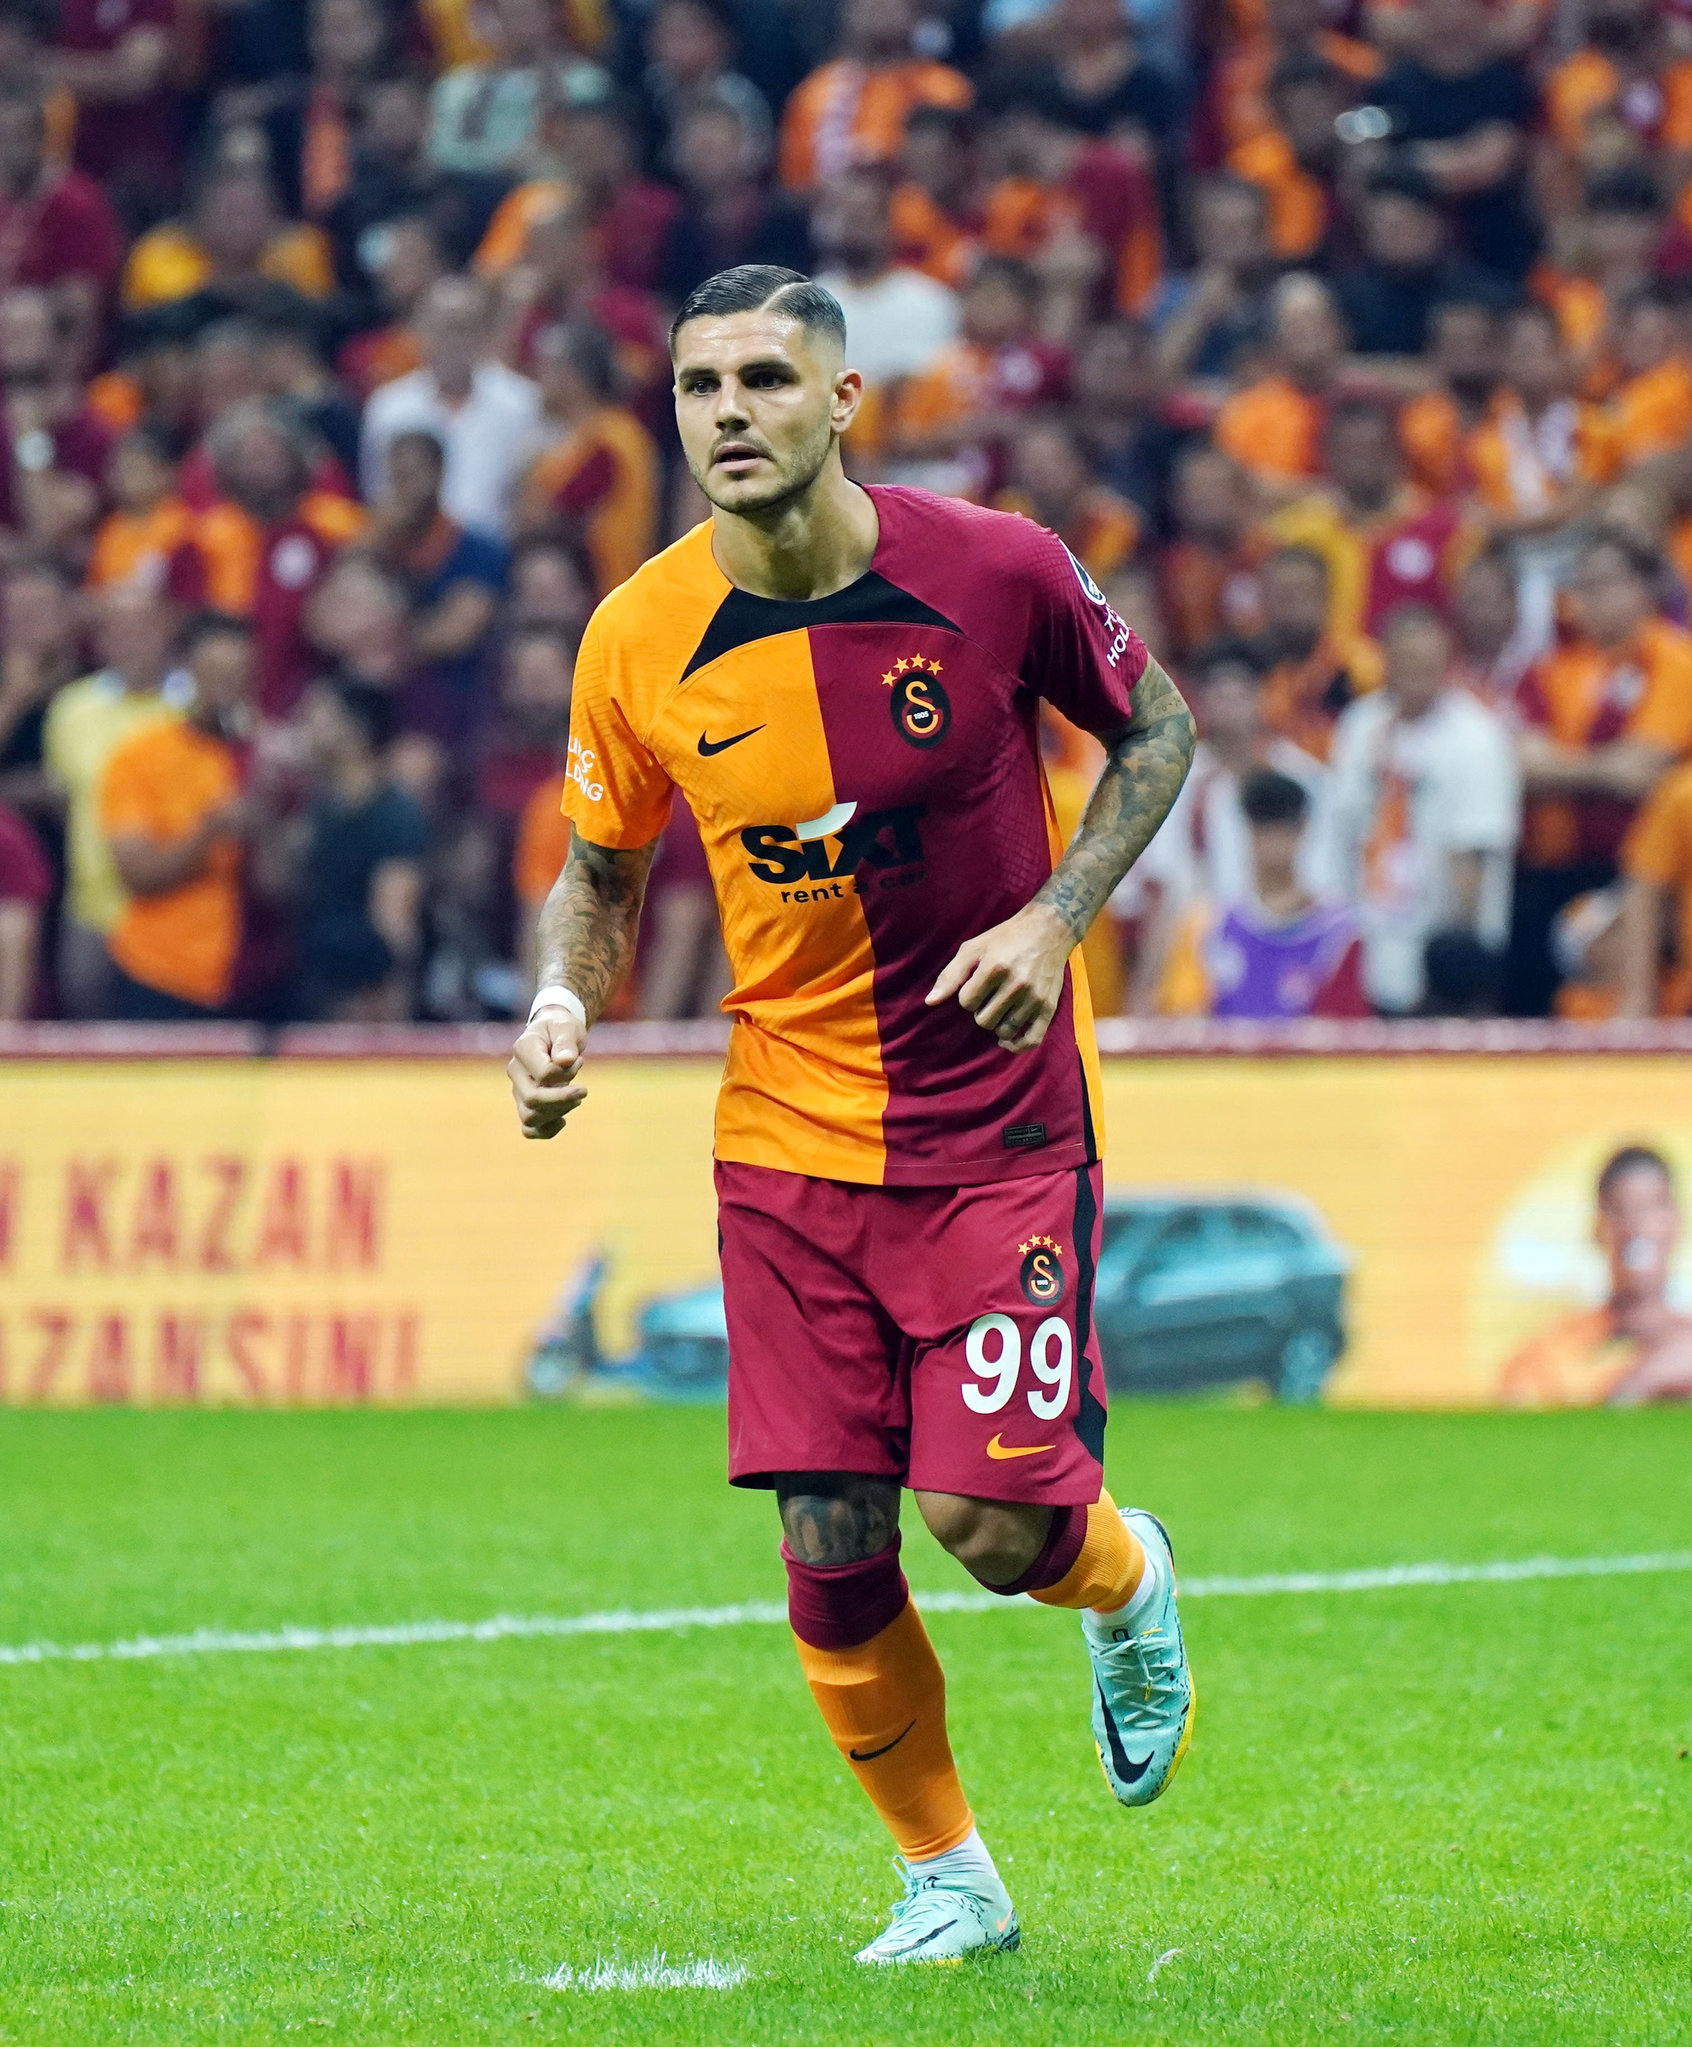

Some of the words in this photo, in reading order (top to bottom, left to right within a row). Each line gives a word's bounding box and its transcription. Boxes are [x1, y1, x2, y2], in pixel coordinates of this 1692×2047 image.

[781, 883, 844, 903] rent
[854, 880, 870, 894] a
[879, 870, 929, 891] car
[62, 1154, 388, 1273] KAZAN
[961, 1312, 1073, 1421] 99
